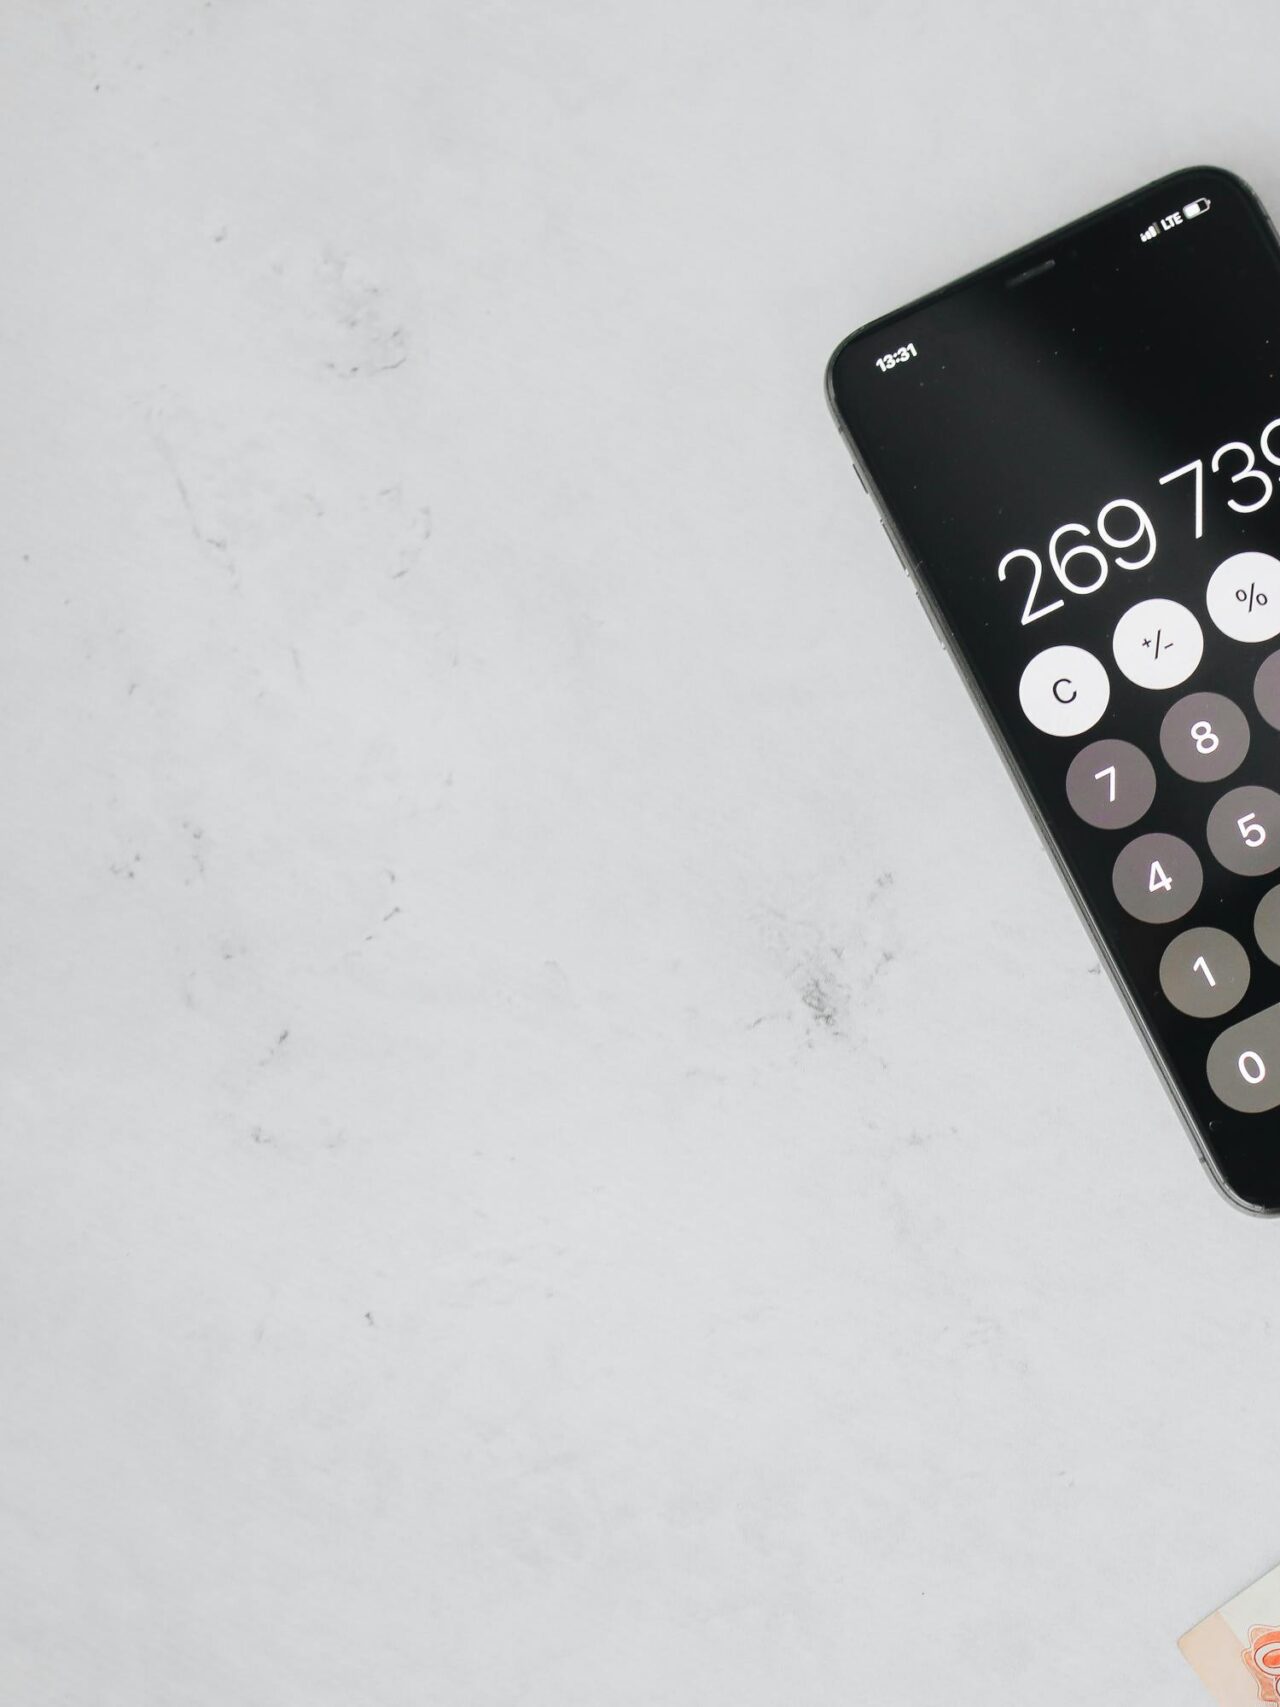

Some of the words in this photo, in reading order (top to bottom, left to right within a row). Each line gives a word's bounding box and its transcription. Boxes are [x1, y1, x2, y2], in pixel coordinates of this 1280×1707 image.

[1161, 208, 1184, 231] LTE
[875, 342, 918, 372] 13:31
[998, 498, 1157, 626] 269
[1052, 678, 1077, 704] C
[1190, 720, 1220, 755] 8
[1094, 765, 1116, 802] 7
[1237, 812, 1266, 848] 5
[1148, 860, 1174, 893] 4
[1193, 956, 1216, 987] 1
[1238, 1050, 1266, 1084] 0
